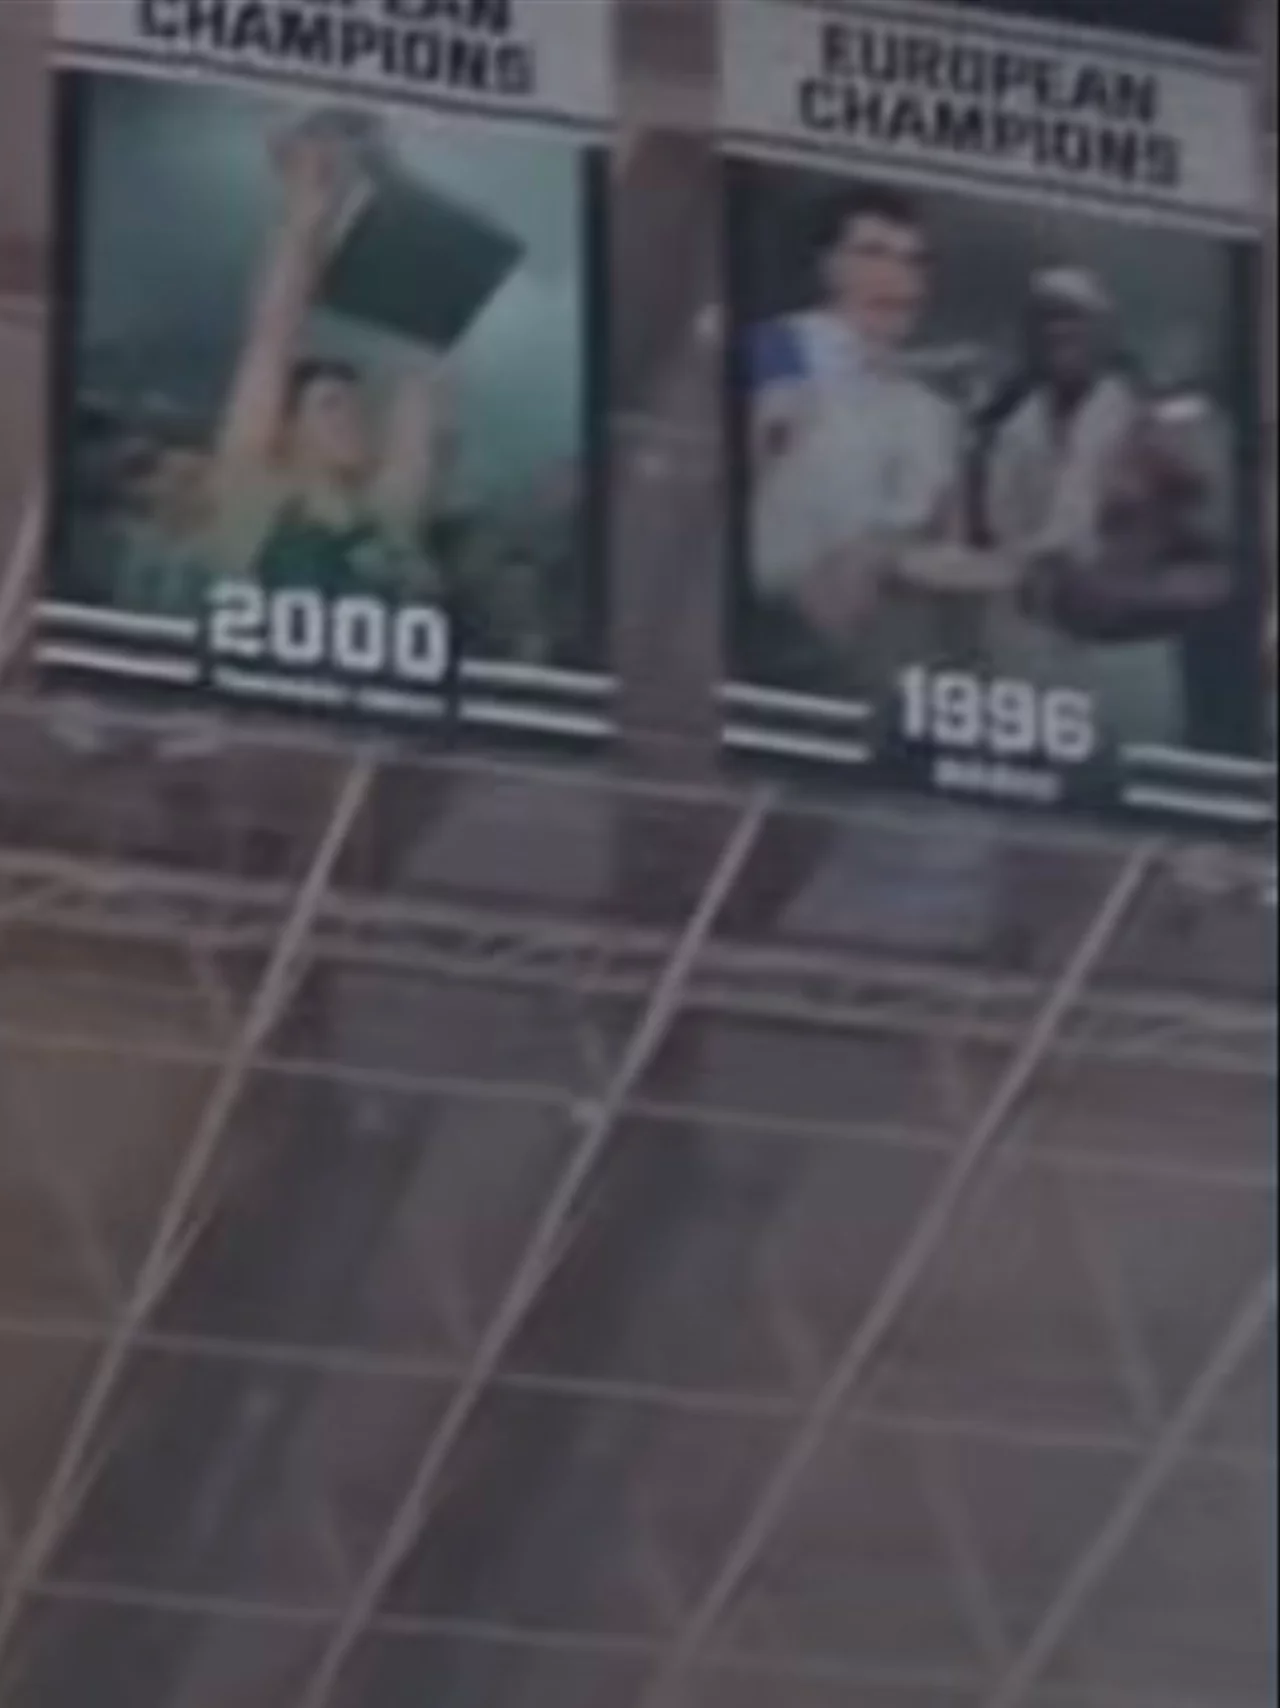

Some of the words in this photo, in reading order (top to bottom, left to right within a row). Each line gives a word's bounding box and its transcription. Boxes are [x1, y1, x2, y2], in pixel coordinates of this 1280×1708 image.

[139, 0, 536, 95] CHAMPIONS
[820, 22, 1160, 124] EUROPEAN
[800, 78, 1182, 188] CHAMPIONS
[204, 578, 450, 684] 2000
[898, 664, 1095, 763] 1996
